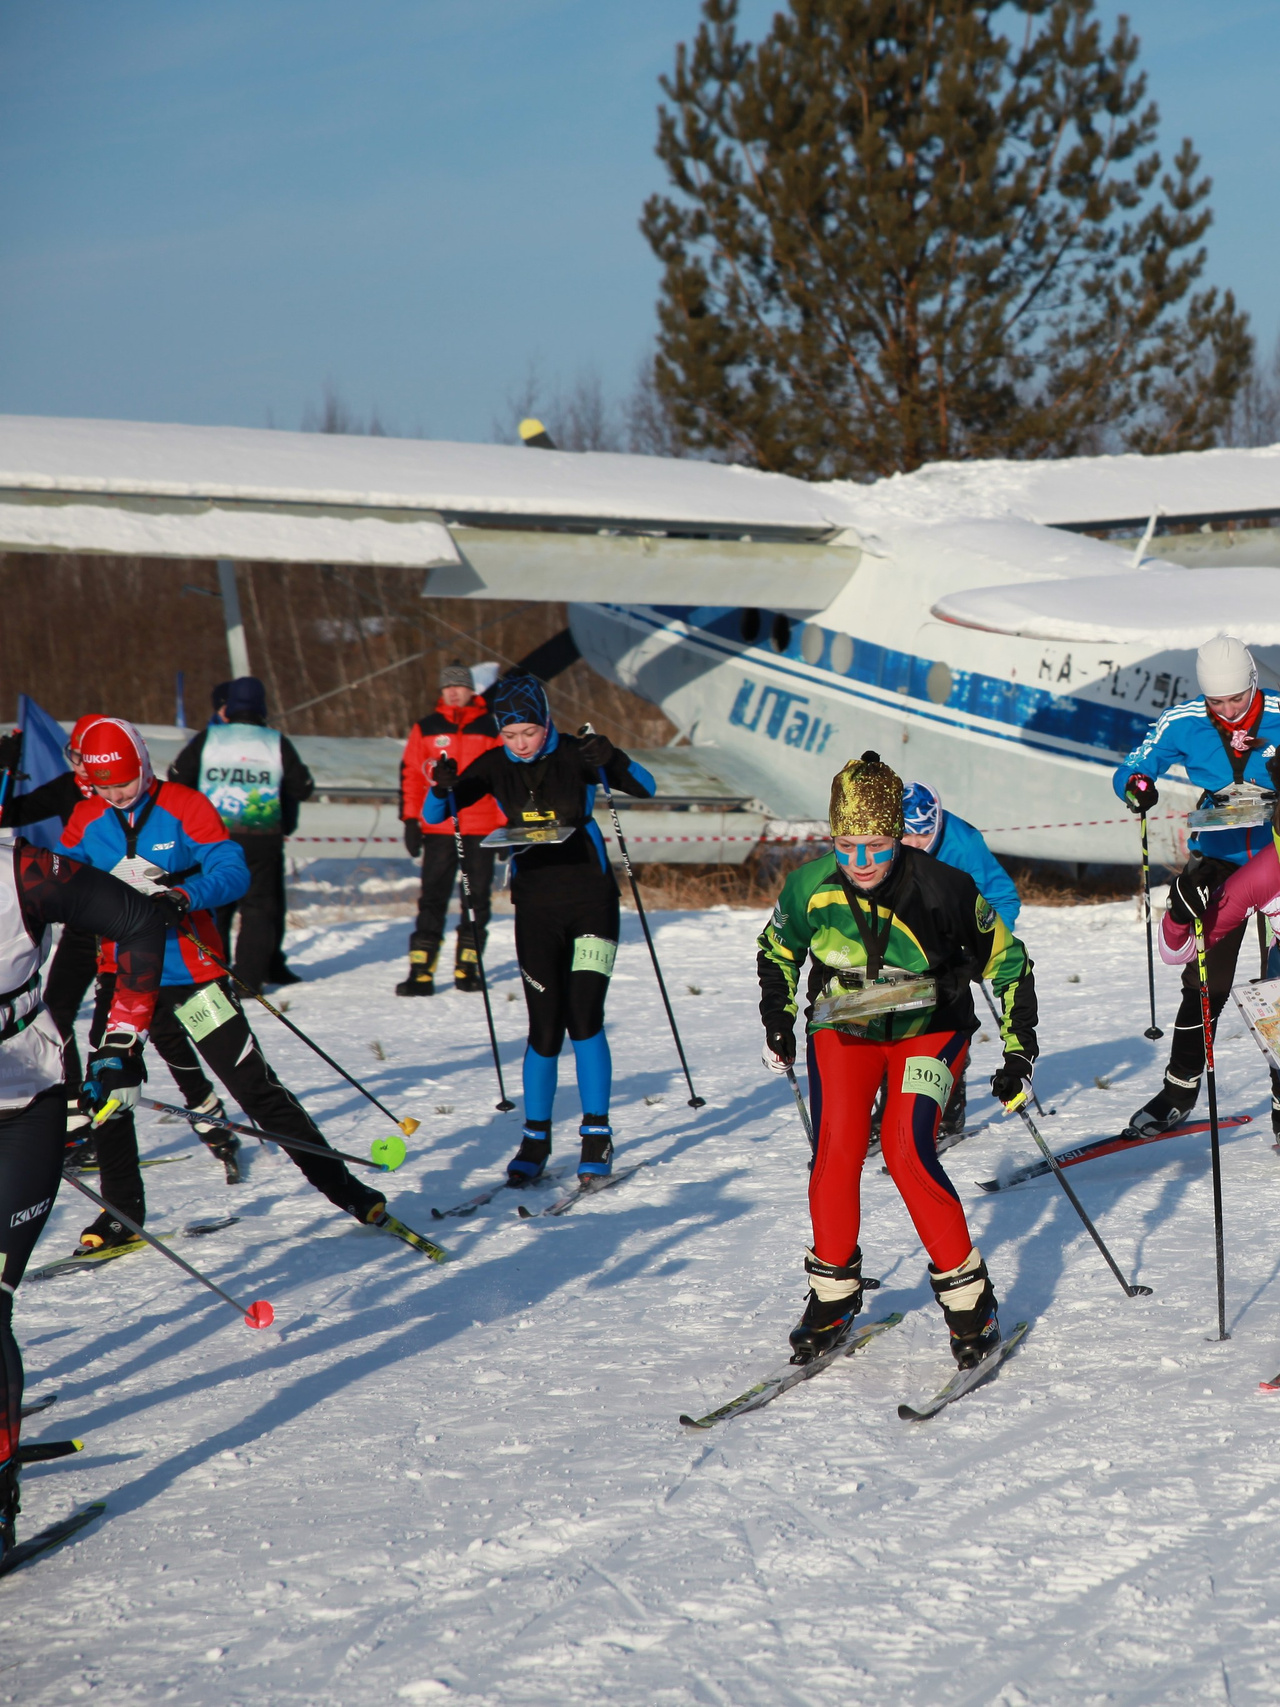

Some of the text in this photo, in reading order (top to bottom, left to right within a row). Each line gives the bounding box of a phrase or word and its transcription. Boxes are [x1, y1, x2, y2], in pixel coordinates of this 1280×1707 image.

[206, 767, 271, 785] СУДЬЯ
[912, 1068, 948, 1096] 302.1
[1057, 1149, 1085, 1163] TISA
[811, 1266, 834, 1275] SALOMON
[949, 1275, 974, 1286] SALOMON
